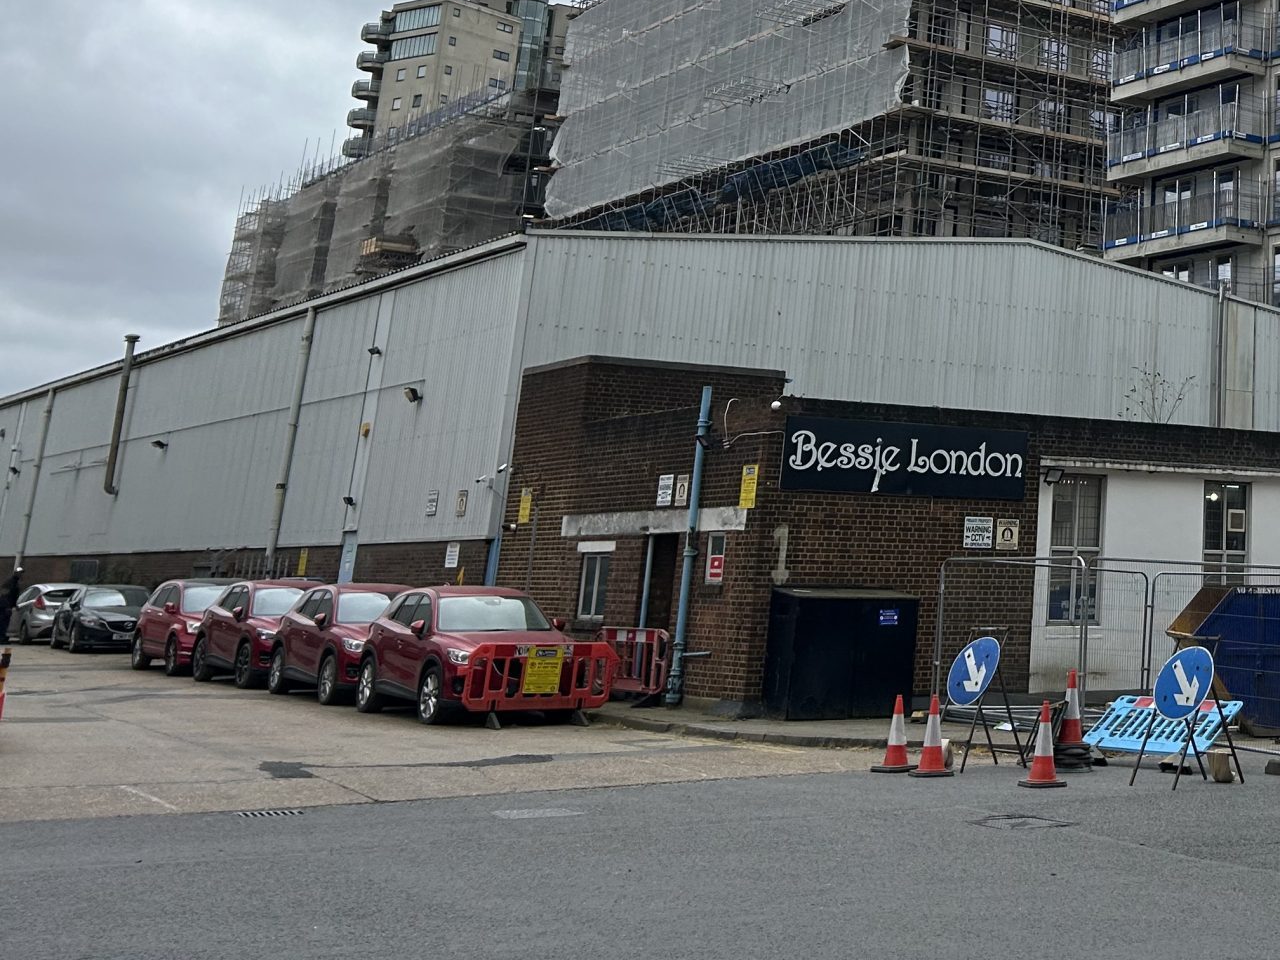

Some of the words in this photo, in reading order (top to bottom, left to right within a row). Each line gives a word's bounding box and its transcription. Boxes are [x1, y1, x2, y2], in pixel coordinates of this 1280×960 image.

[789, 430, 901, 493] Bessie
[906, 438, 1023, 478] London
[966, 525, 992, 533] WARNING
